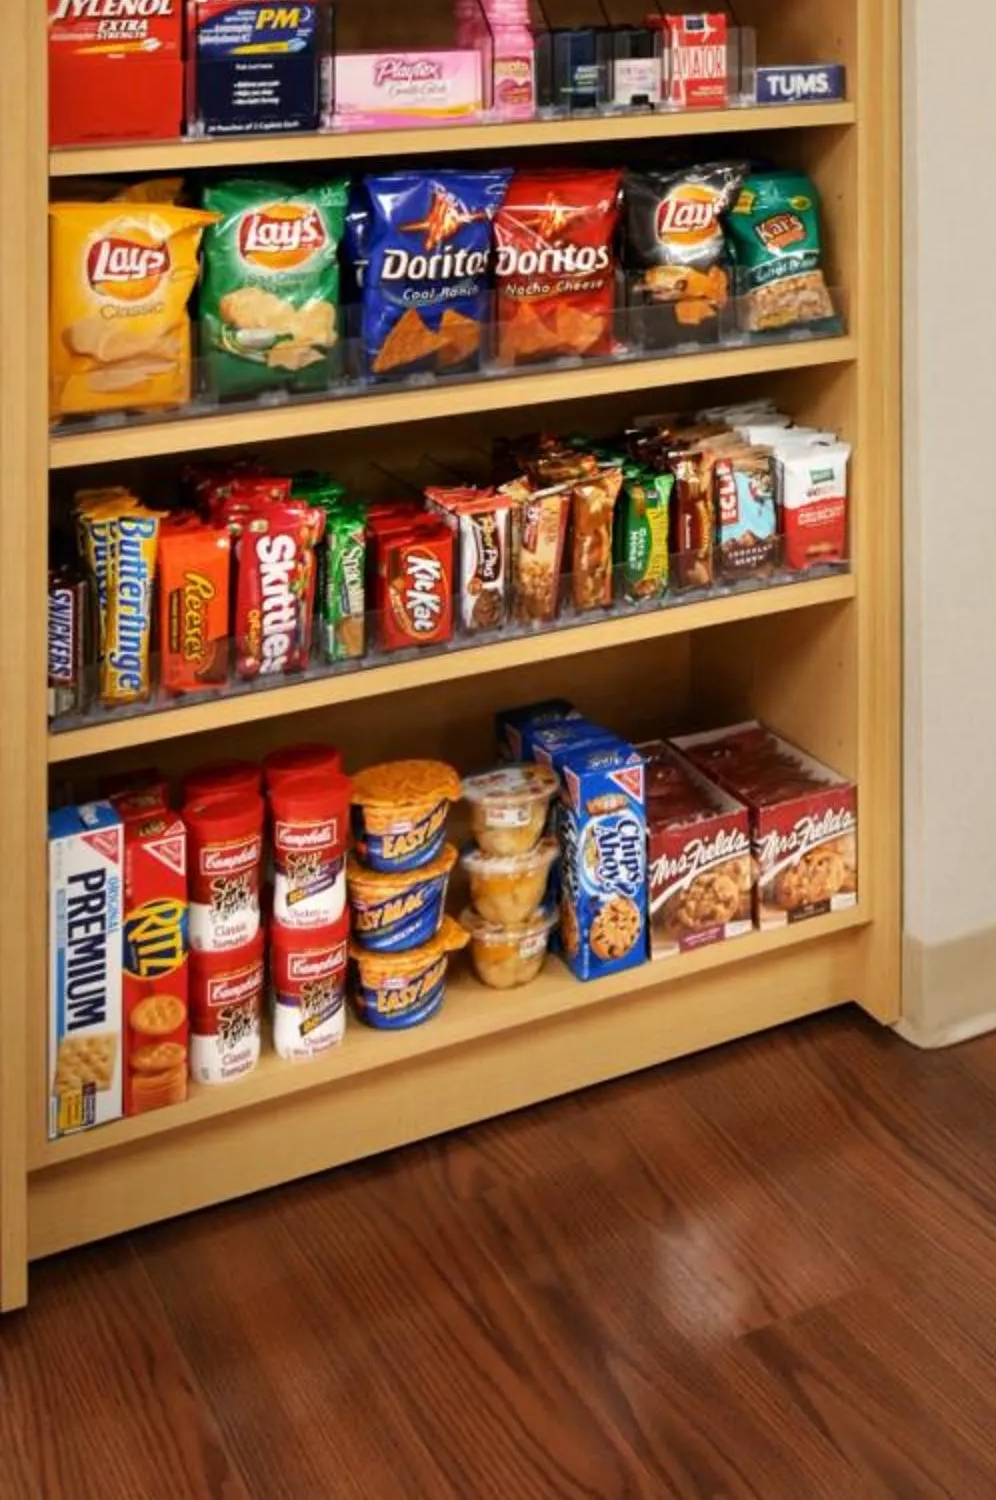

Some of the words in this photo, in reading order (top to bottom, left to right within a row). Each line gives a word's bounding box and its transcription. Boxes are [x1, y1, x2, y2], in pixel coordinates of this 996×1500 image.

[99, 19, 147, 32] EXTRA
[256, 7, 301, 30] PM
[672, 46, 728, 79] AVIATOR
[767, 73, 829, 97] TUMS
[245, 210, 322, 252] Lay's
[495, 240, 609, 278] Doritos
[402, 288, 435, 301] Cool
[505, 282, 549, 297] Nacho
[556, 278, 604, 293] Cheese
[112, 516, 158, 692] Butterfinger
[183, 572, 216, 663] Reese's
[48, 588, 73, 680] SNICKERS
[617, 819, 641, 883] Chips
[107, 875, 120, 932] ORIGINAL
[67, 867, 107, 1031] PREMIUM
